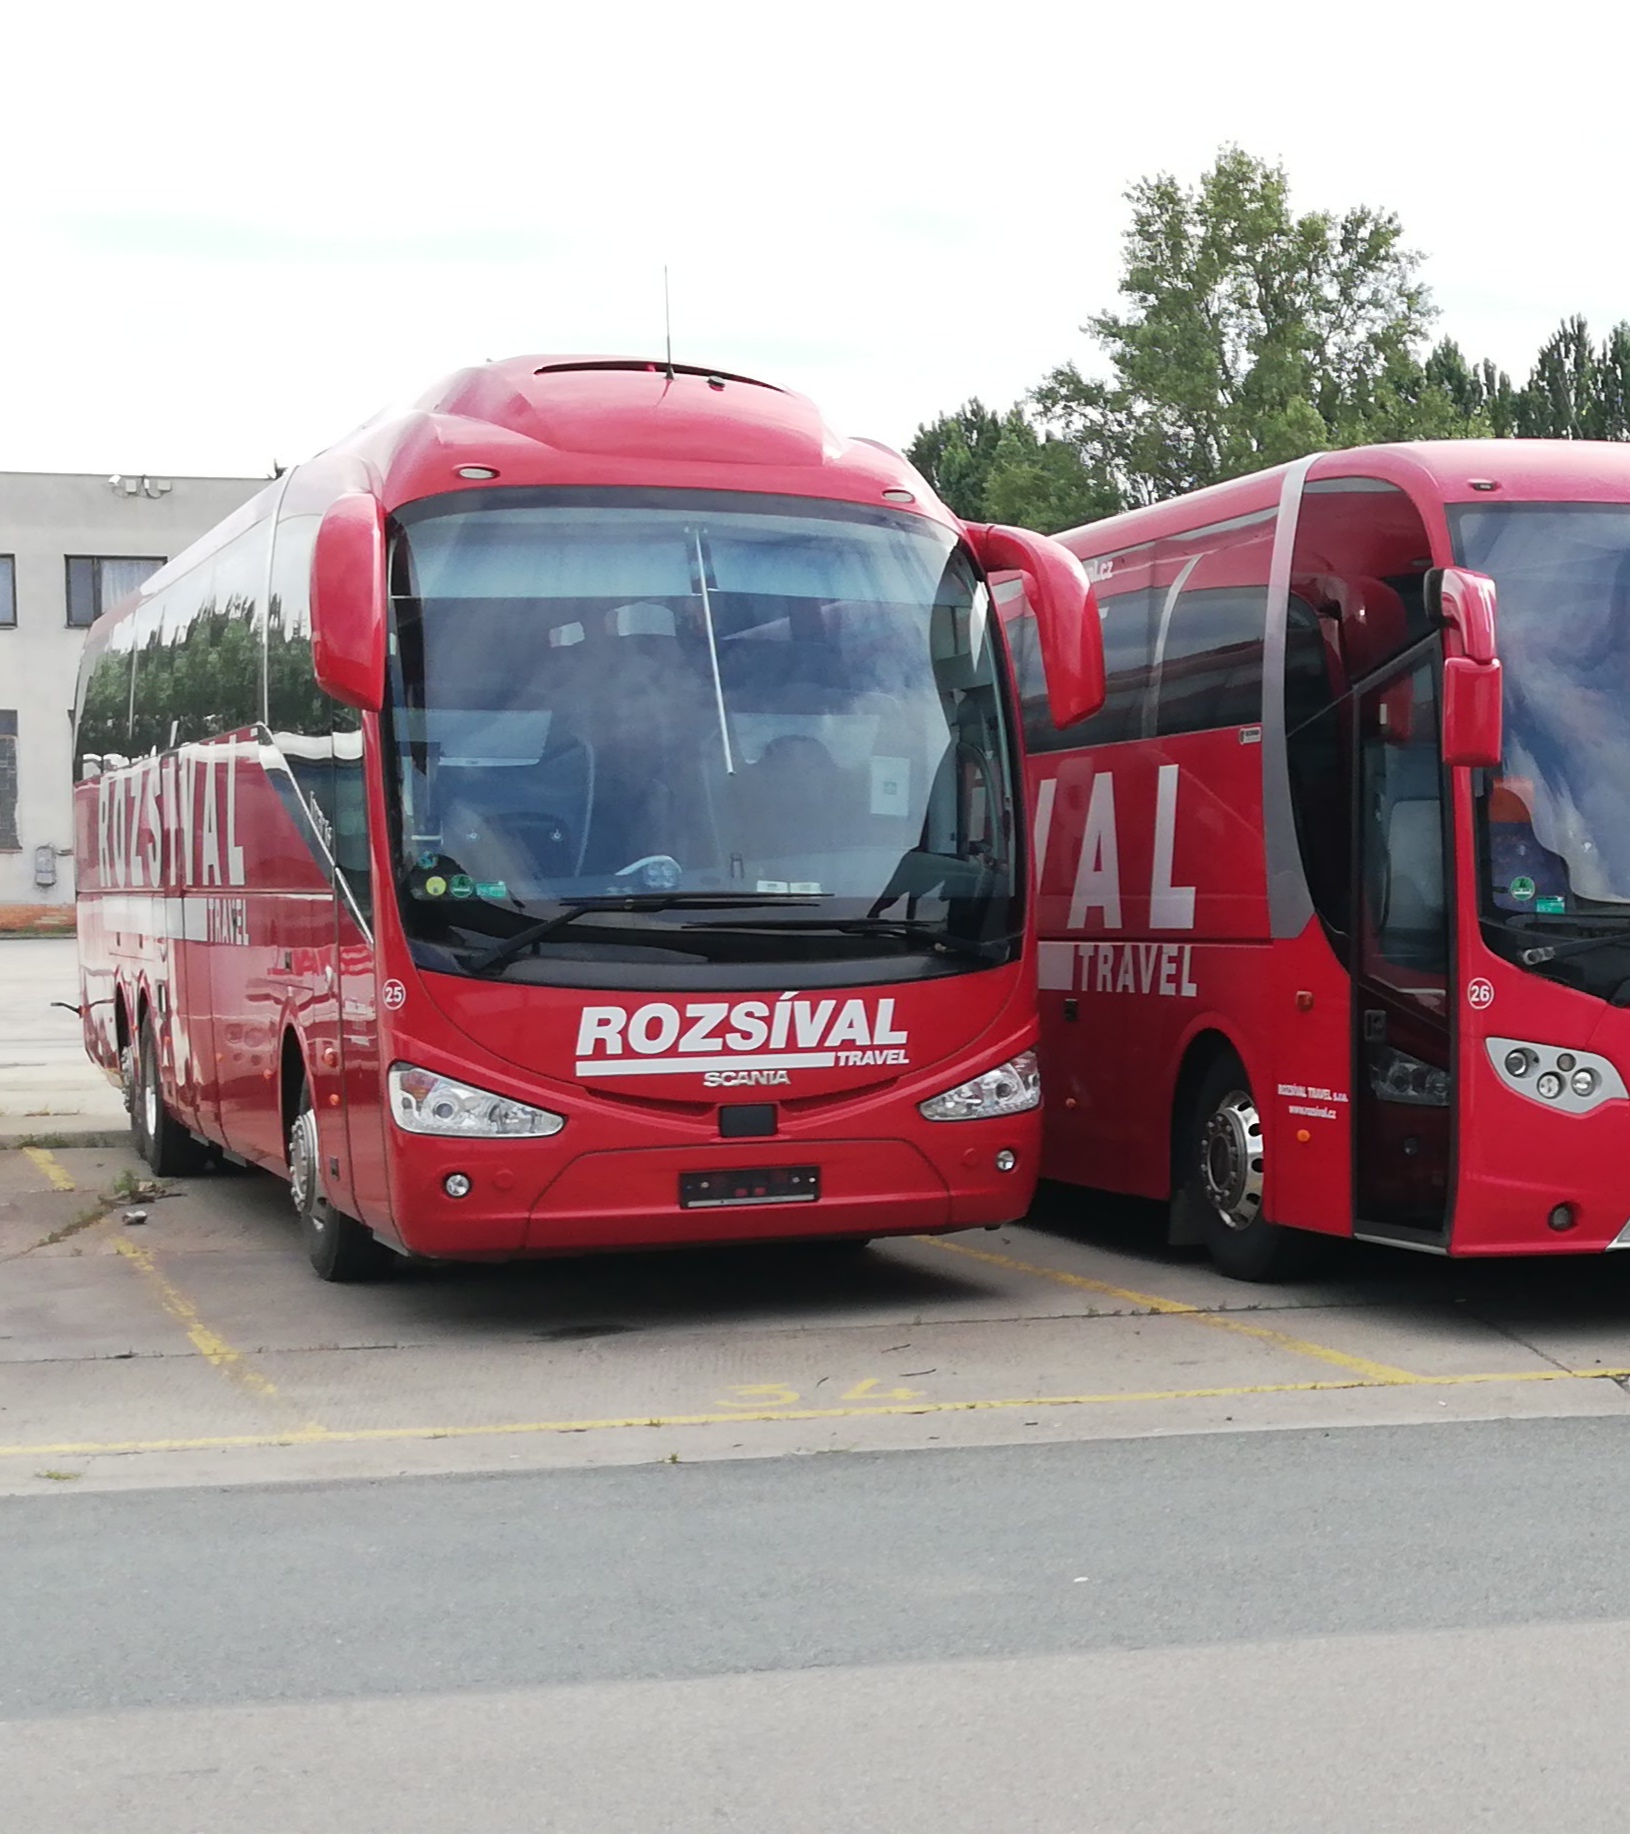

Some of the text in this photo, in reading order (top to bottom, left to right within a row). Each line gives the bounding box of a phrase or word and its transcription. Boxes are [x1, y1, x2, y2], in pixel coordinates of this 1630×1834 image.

[207, 898, 249, 945] TRAVEL
[1078, 944, 1197, 997] TRAVEL
[384, 986, 403, 1003] 25
[1471, 985, 1490, 1002] 26
[576, 991, 908, 1056] ROZSÍVAL
[837, 1049, 910, 1067] TRAVEL
[703, 1070, 792, 1087] SCANIA
